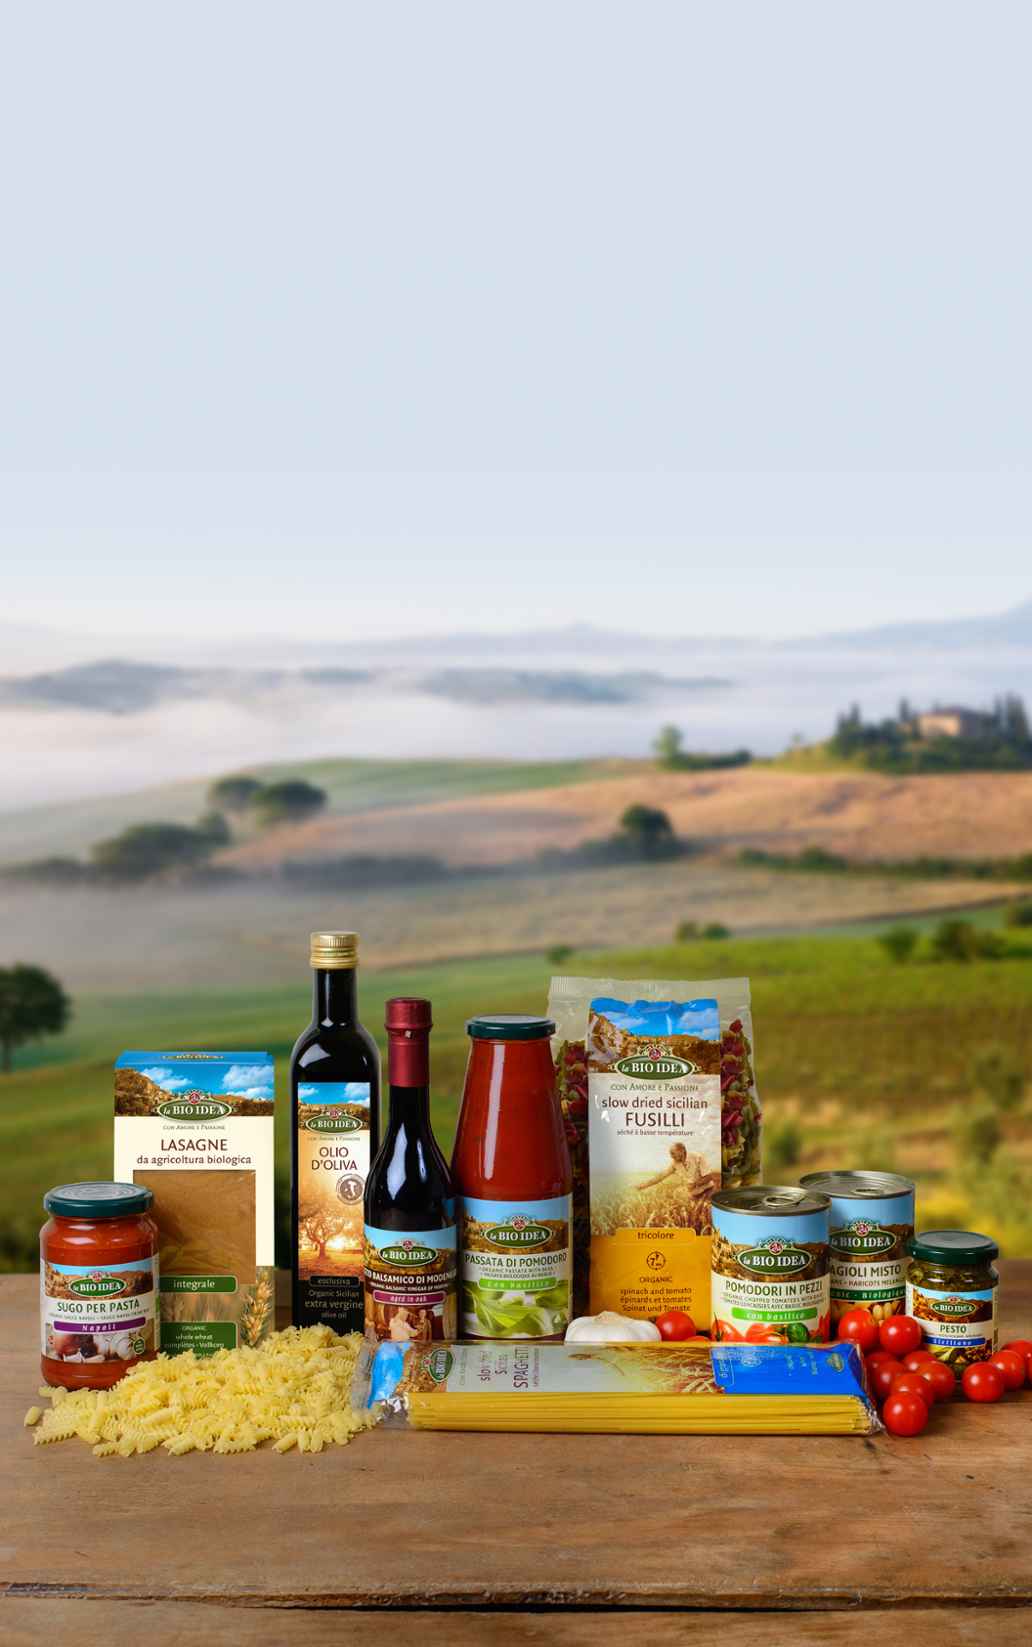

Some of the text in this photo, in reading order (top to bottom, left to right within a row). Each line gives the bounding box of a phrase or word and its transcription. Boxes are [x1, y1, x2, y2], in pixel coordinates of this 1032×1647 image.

[632, 1063, 653, 1073] BIO
[656, 1063, 688, 1073] IDEA
[602, 1097, 708, 1109] slow dried sicilian
[173, 1106, 193, 1114] BIO
[196, 1106, 225, 1114] IDEA
[626, 1113, 684, 1127] FUSILLI
[161, 1139, 228, 1151] LASAGNE
[320, 1147, 348, 1157] OLIO
[137, 1155, 251, 1166] da agricoltura biologica
[312, 1160, 357, 1170] D'OLIVA
[499, 1232, 518, 1240] BIO
[521, 1232, 545, 1240] IDEA
[840, 1237, 860, 1247] BIO
[864, 1237, 890, 1247] IDEA
[390, 1251, 406, 1260] BIO
[465, 1253, 567, 1267] PASSATA DI POMODORO
[753, 1256, 774, 1266] BIO
[778, 1256, 805, 1266] IDEA
[871, 1265, 901, 1277] MISTO
[373, 1271, 414, 1283] BALSAMICO
[98, 1282, 121, 1291] IDEA
[174, 1280, 215, 1290] integrale
[726, 1281, 782, 1296] POMODORI
[786, 1286, 796, 1295] IN
[800, 1281, 822, 1293] PEZZI
[57, 1300, 140, 1312] SUGO PER PASTA
[329, 1300, 364, 1310] vergine
[940, 1325, 966, 1333] PESTO
